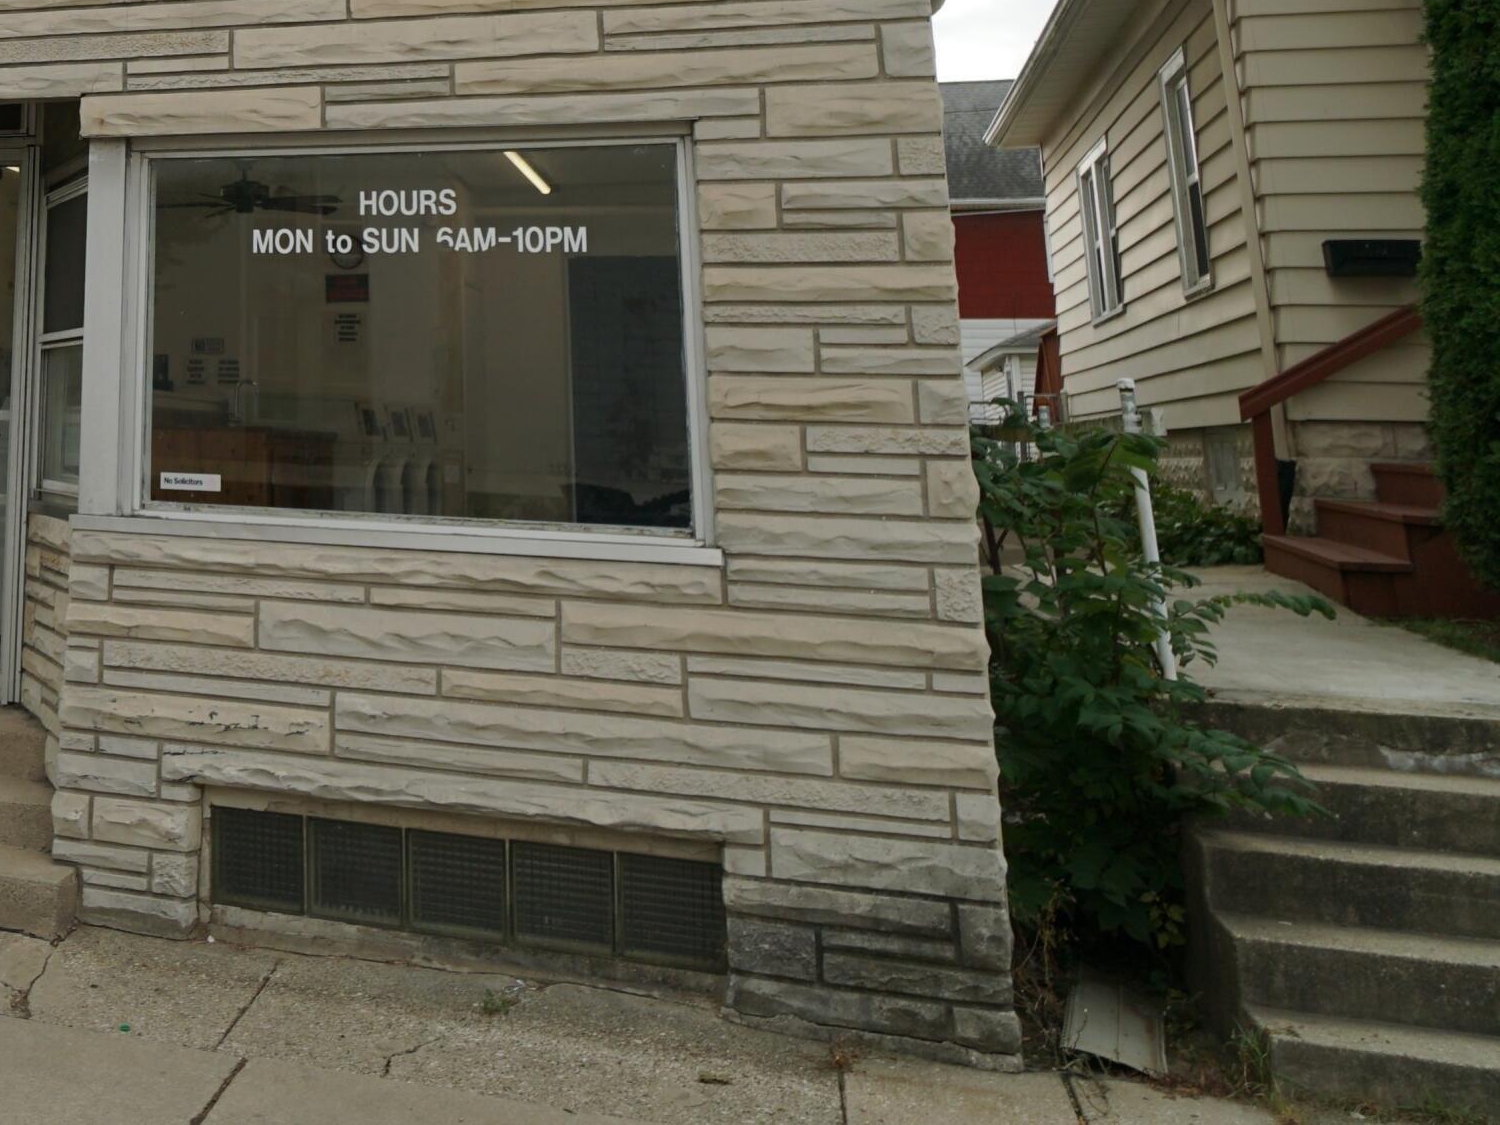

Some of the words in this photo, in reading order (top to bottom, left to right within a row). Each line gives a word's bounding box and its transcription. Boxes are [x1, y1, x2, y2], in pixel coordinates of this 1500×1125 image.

[359, 188, 457, 216] HOURS
[252, 228, 314, 254] MON
[325, 228, 353, 254] to
[362, 227, 420, 254] SUN
